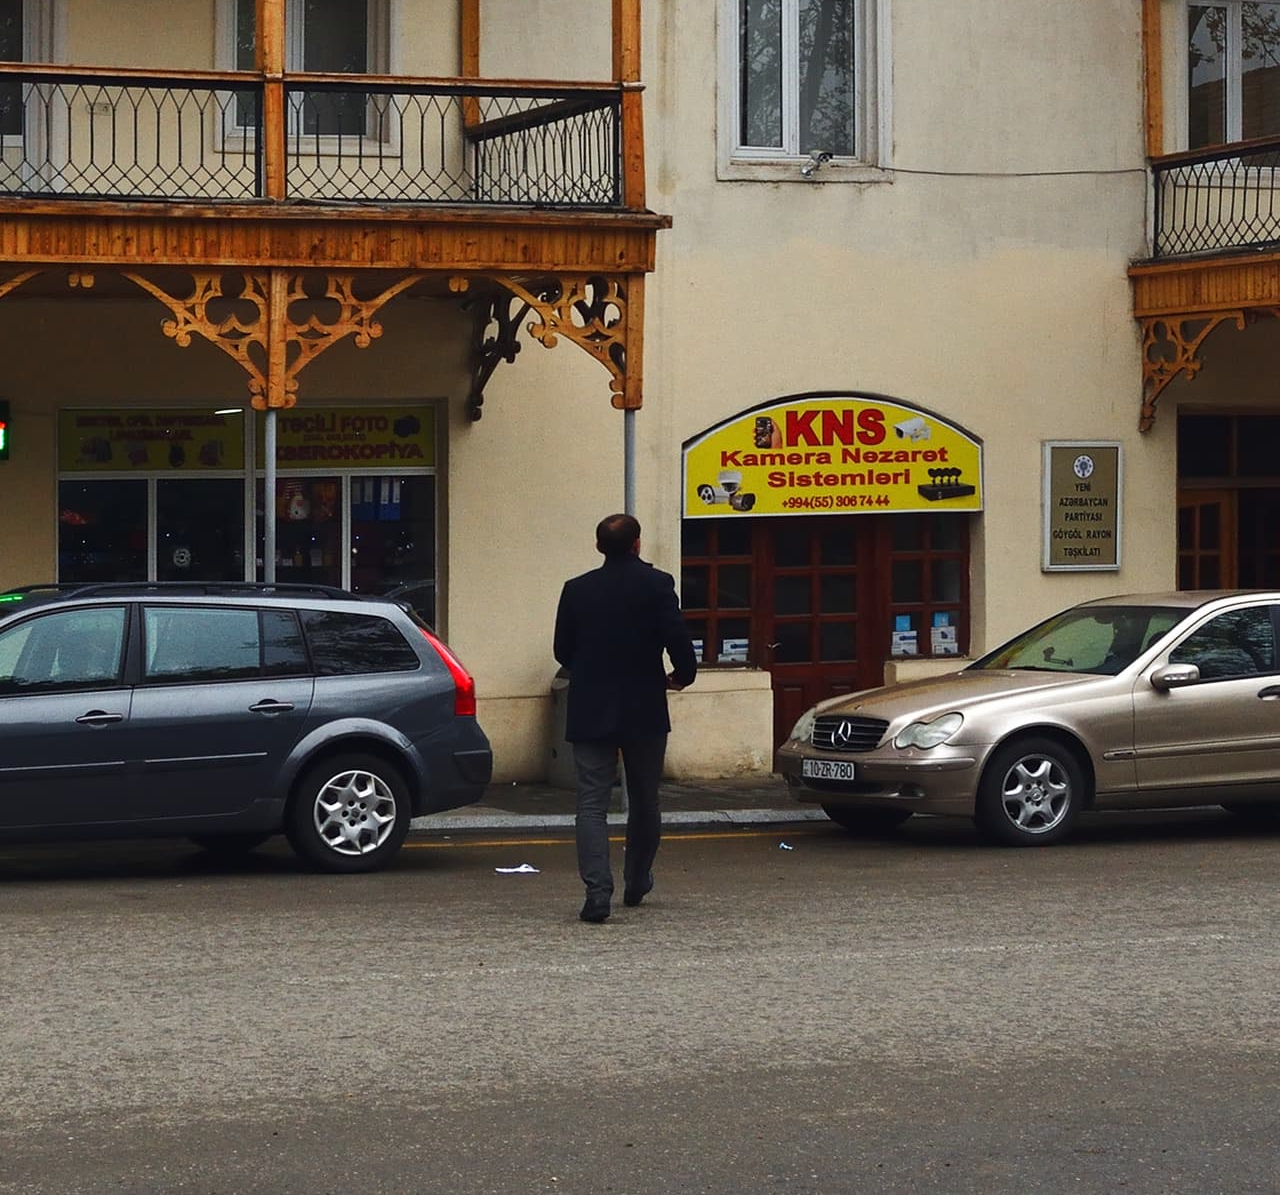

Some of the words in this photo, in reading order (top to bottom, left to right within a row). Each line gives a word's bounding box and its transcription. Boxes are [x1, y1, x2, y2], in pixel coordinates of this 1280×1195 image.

[341, 415, 388, 433] FOTO
[785, 408, 887, 447] KNS
[720, 450, 832, 467] Kamera
[841, 447, 948, 464] Nəzarət
[767, 468, 910, 488] Sistemləri
[782, 495, 834, 509] +994(55)
[835, 495, 858, 507] 306
[859, 495, 874, 506] 74
[875, 494, 890, 506] 44
[1086, 530, 1111, 539] RAYON
[810, 761, 852, 778] 10-ZR-780
